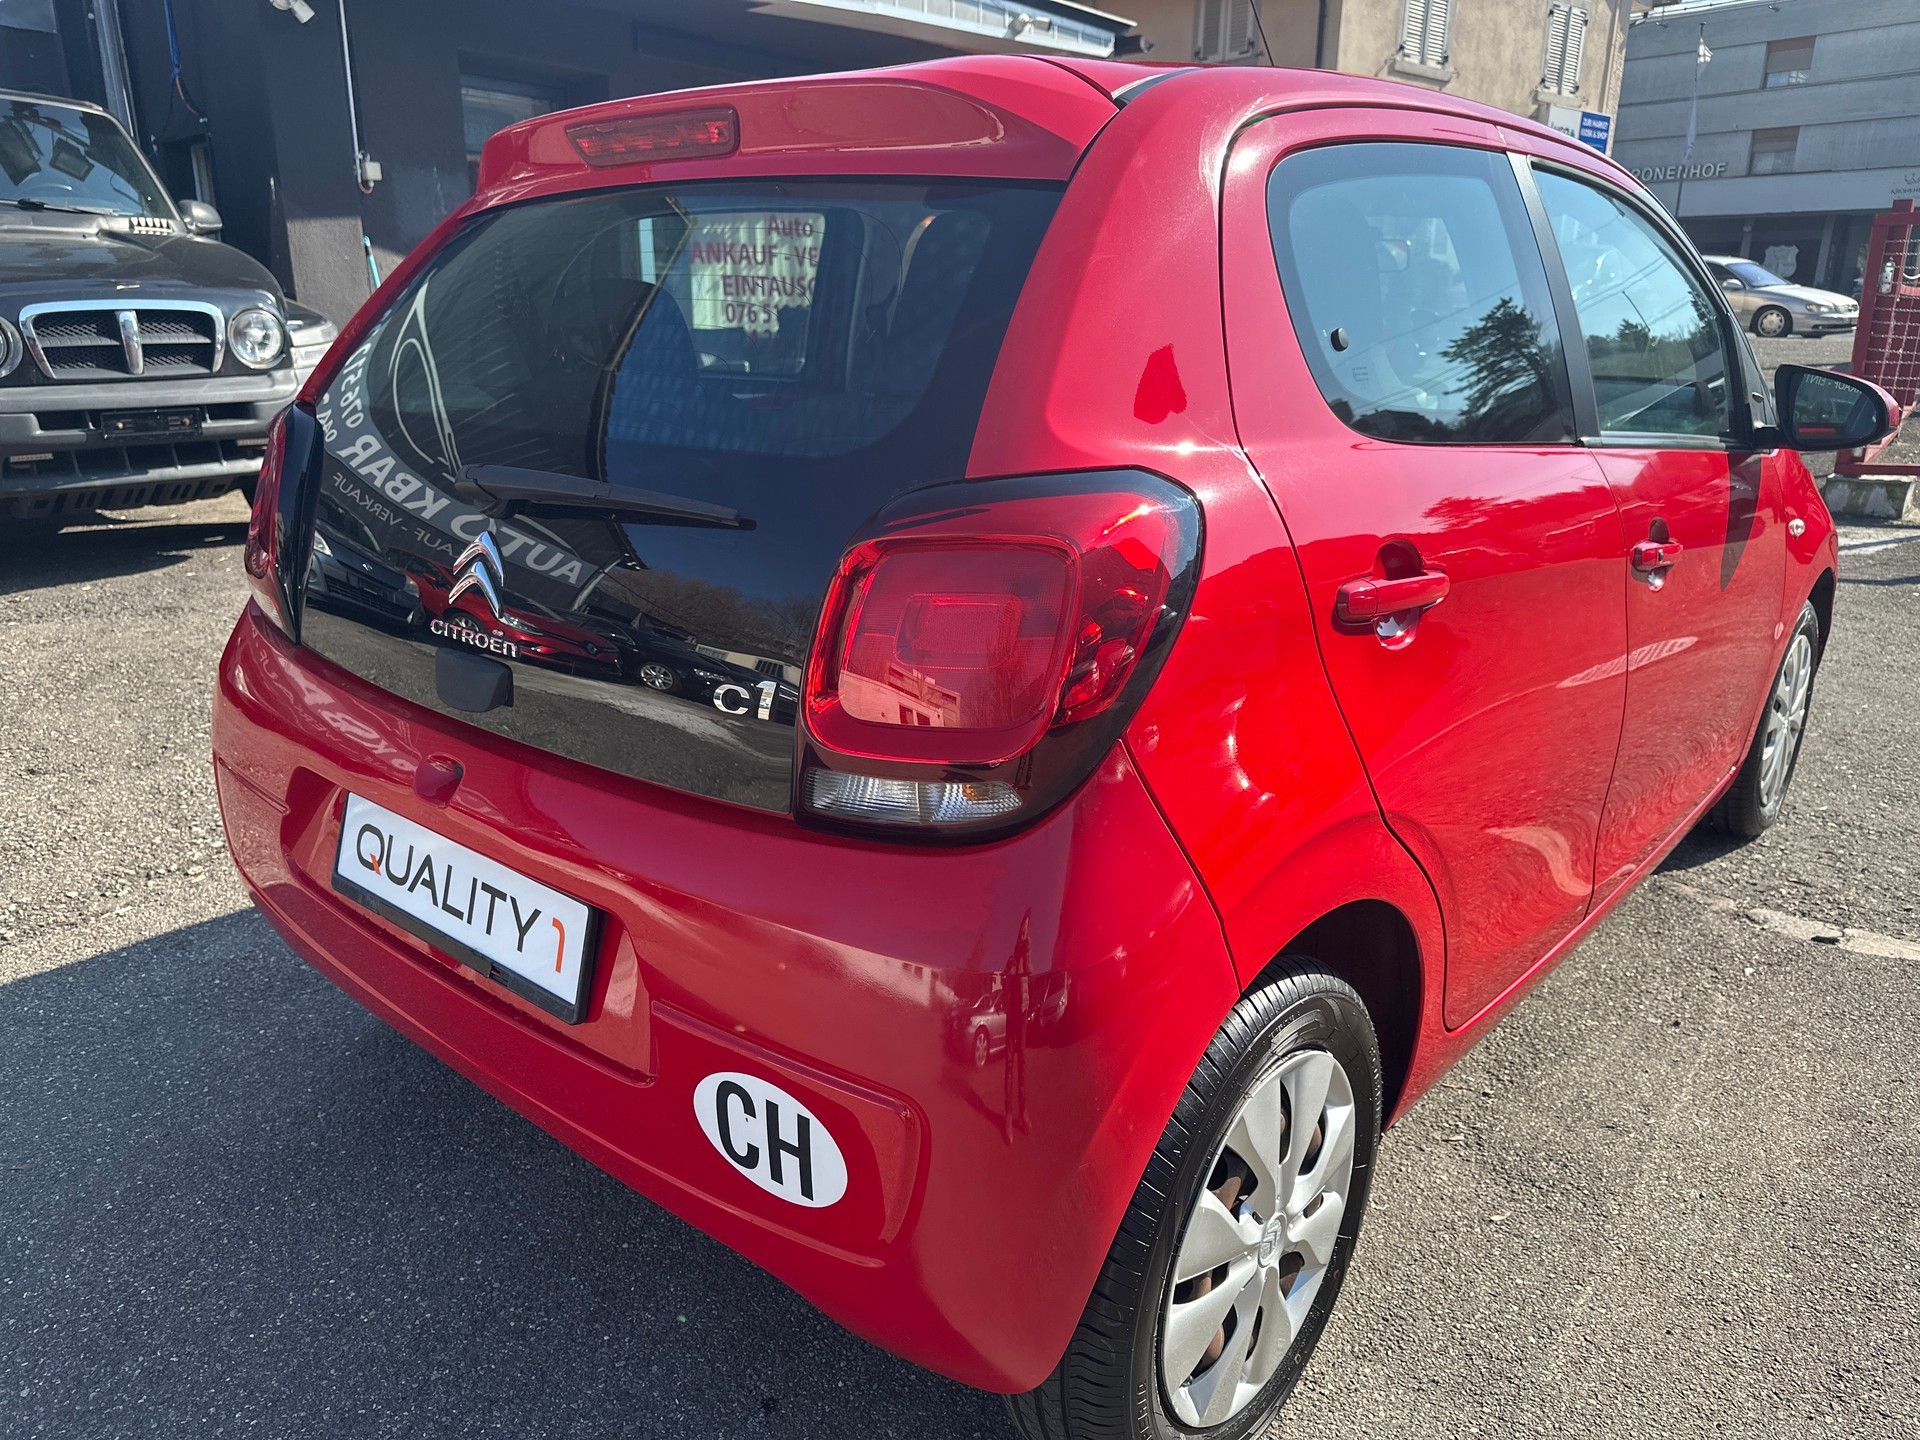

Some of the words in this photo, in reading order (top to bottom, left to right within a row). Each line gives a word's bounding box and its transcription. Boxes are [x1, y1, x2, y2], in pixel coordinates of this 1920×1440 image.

[768, 214, 813, 237] Auto
[691, 241, 778, 266] ANKAUF
[716, 1080, 814, 1202] CH
